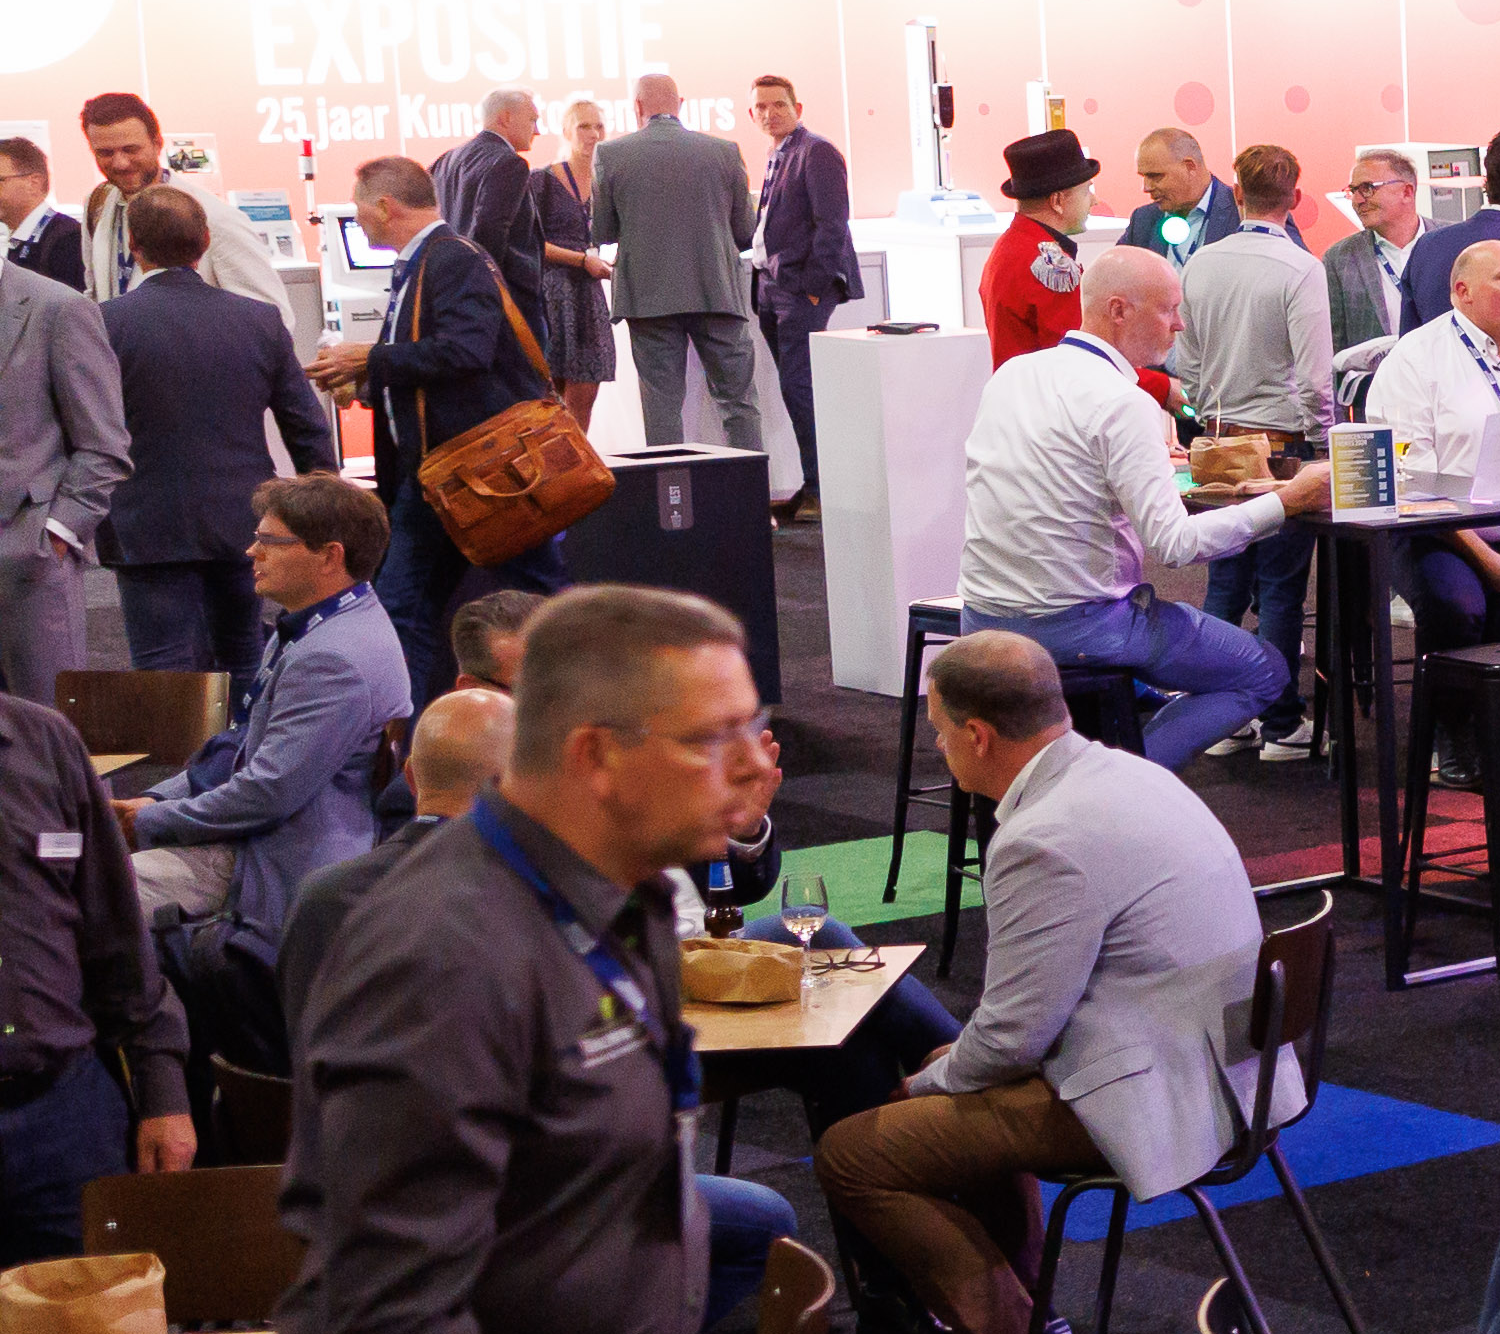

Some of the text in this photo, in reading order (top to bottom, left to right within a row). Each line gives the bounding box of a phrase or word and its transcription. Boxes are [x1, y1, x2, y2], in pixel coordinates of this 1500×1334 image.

[257, 96, 312, 143] 25
[316, 94, 389, 150] jaar
[669, 485, 681, 505] REST
